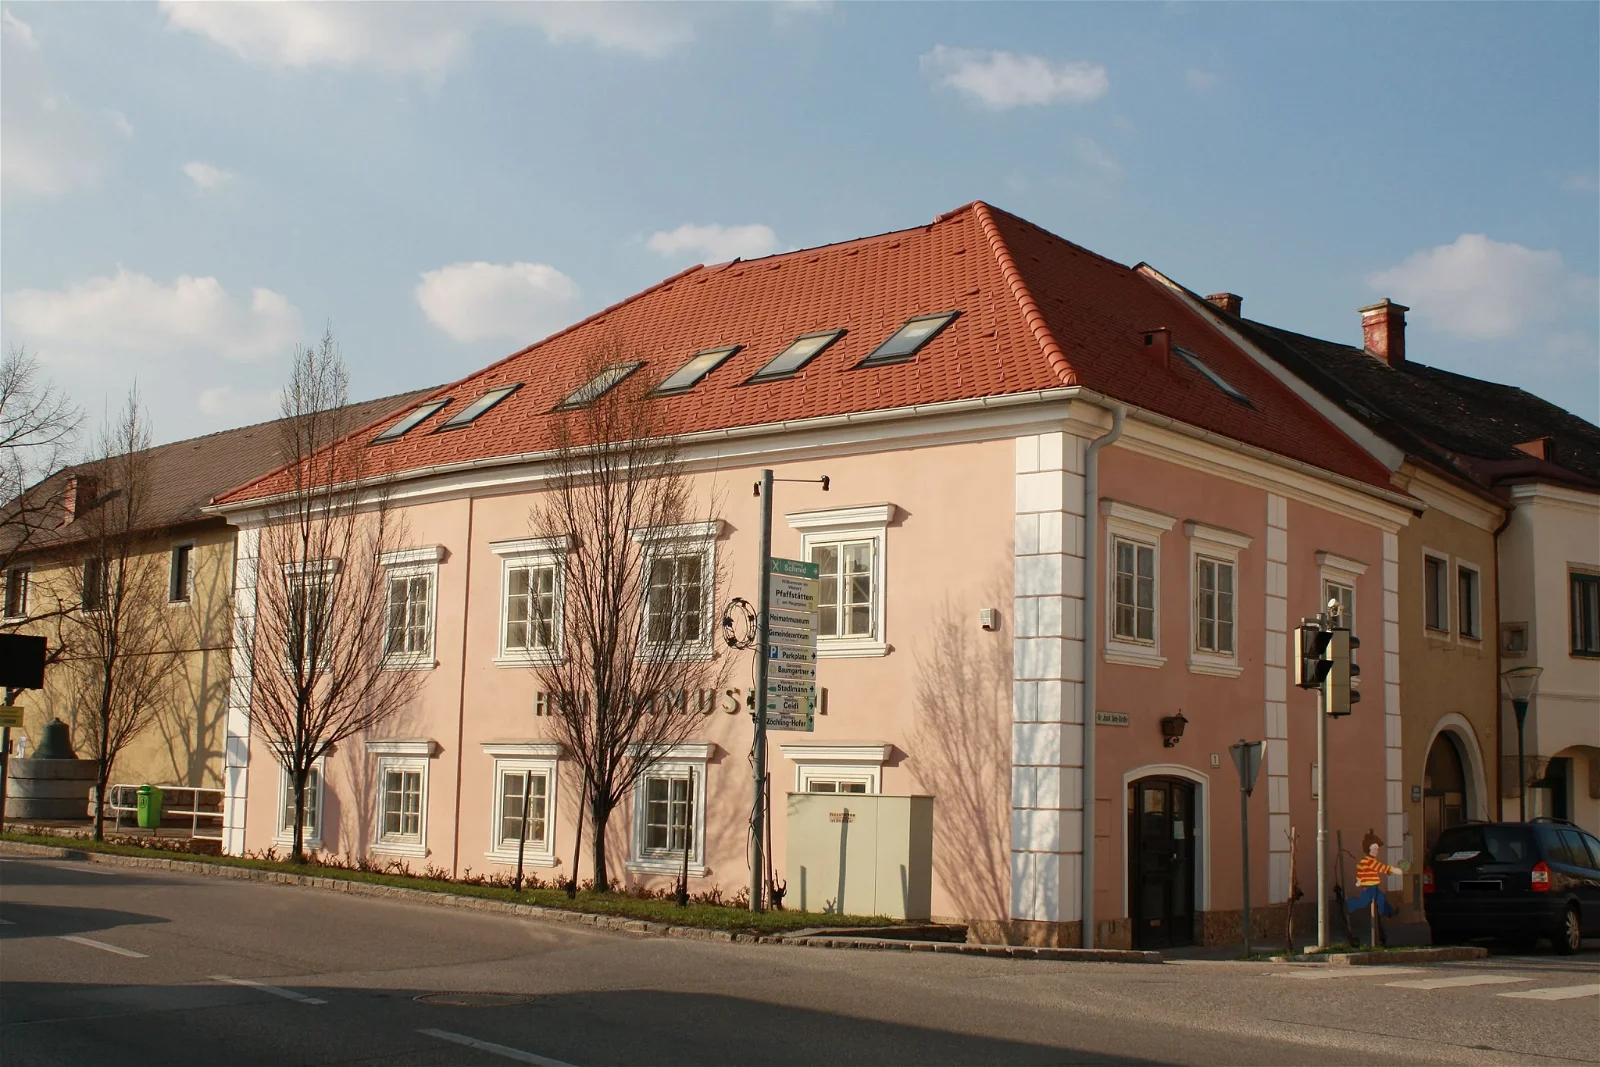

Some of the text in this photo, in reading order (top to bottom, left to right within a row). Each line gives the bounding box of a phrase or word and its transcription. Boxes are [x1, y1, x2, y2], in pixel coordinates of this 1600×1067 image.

[784, 564, 807, 574] Schmid
[775, 589, 814, 601] Pfaffstätten
[769, 613, 810, 625] Heimatmuseum
[768, 629, 810, 640] Gemeindezentrum
[770, 646, 777, 658] P
[782, 651, 808, 661] Parkplatz
[777, 665, 810, 676] Baumgartner
[777, 684, 808, 693] Stadlmann
